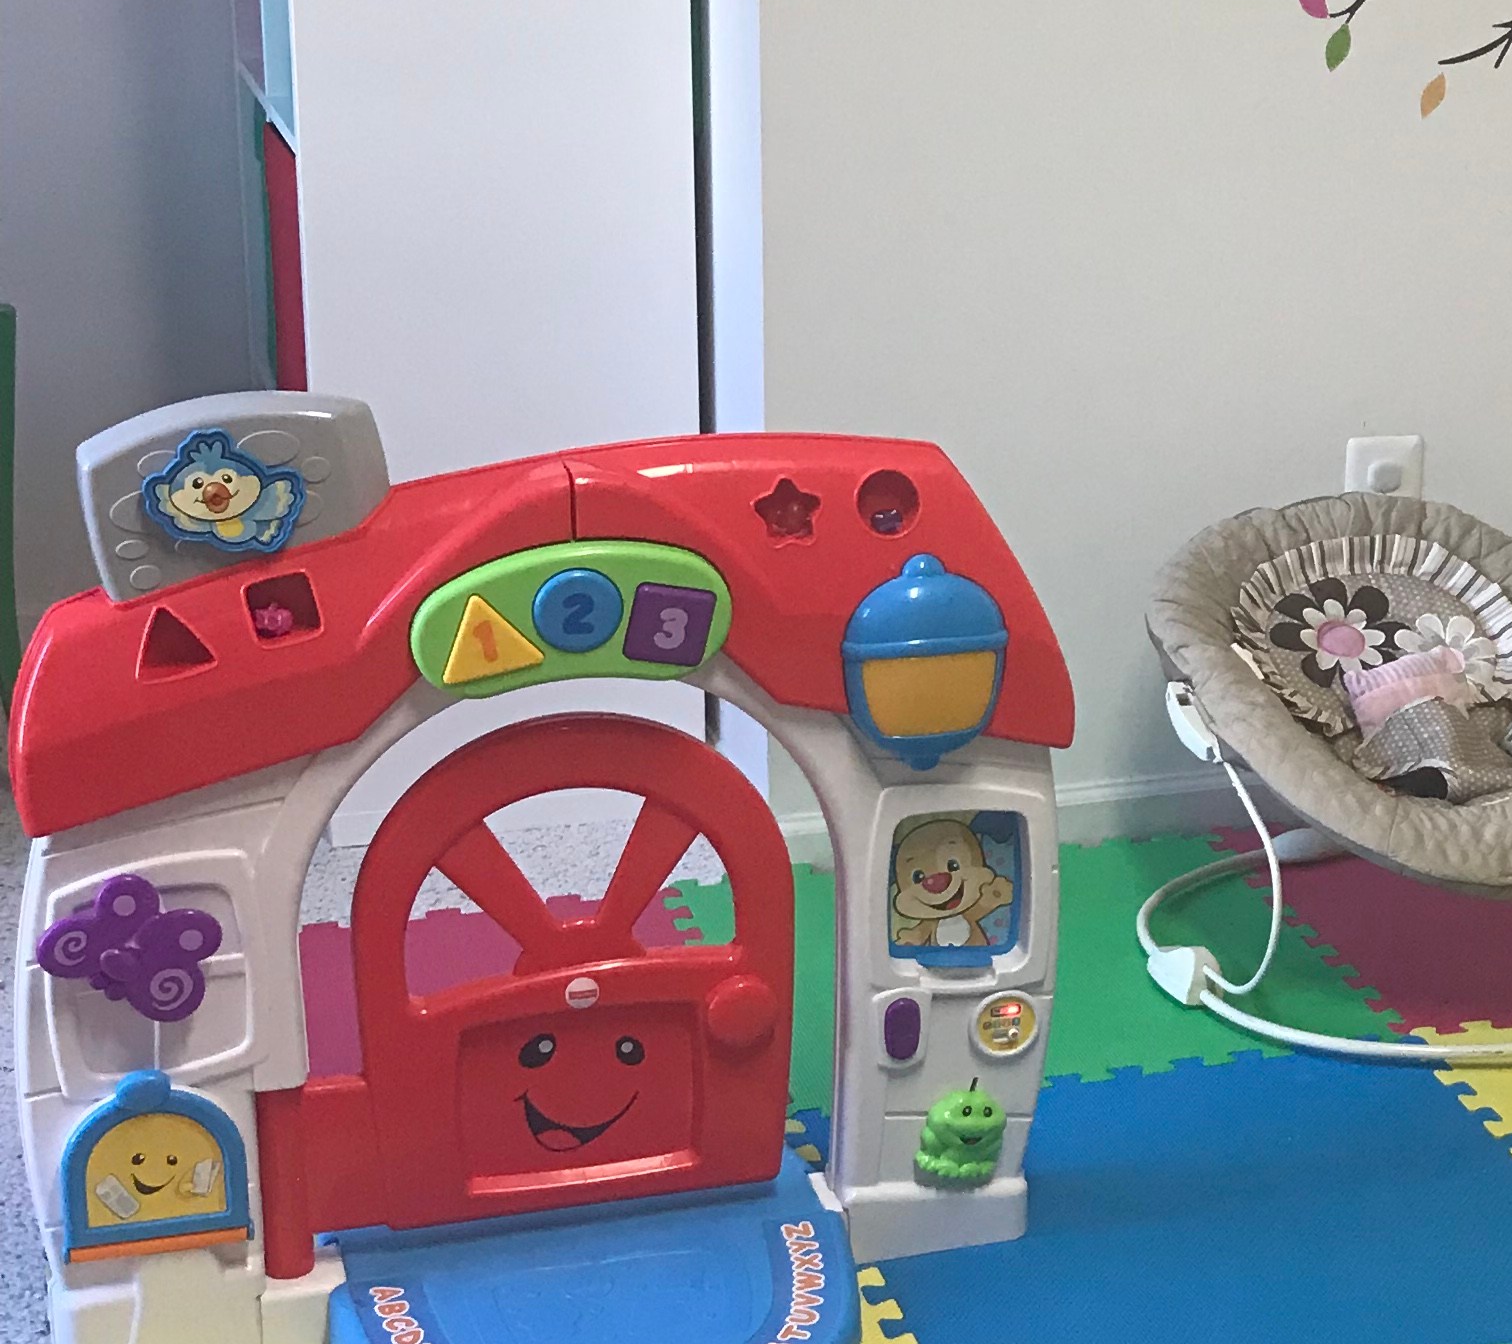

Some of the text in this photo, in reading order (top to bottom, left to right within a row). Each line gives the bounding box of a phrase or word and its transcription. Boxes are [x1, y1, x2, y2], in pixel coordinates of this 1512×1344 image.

[472, 593, 688, 663] 1 2 3
